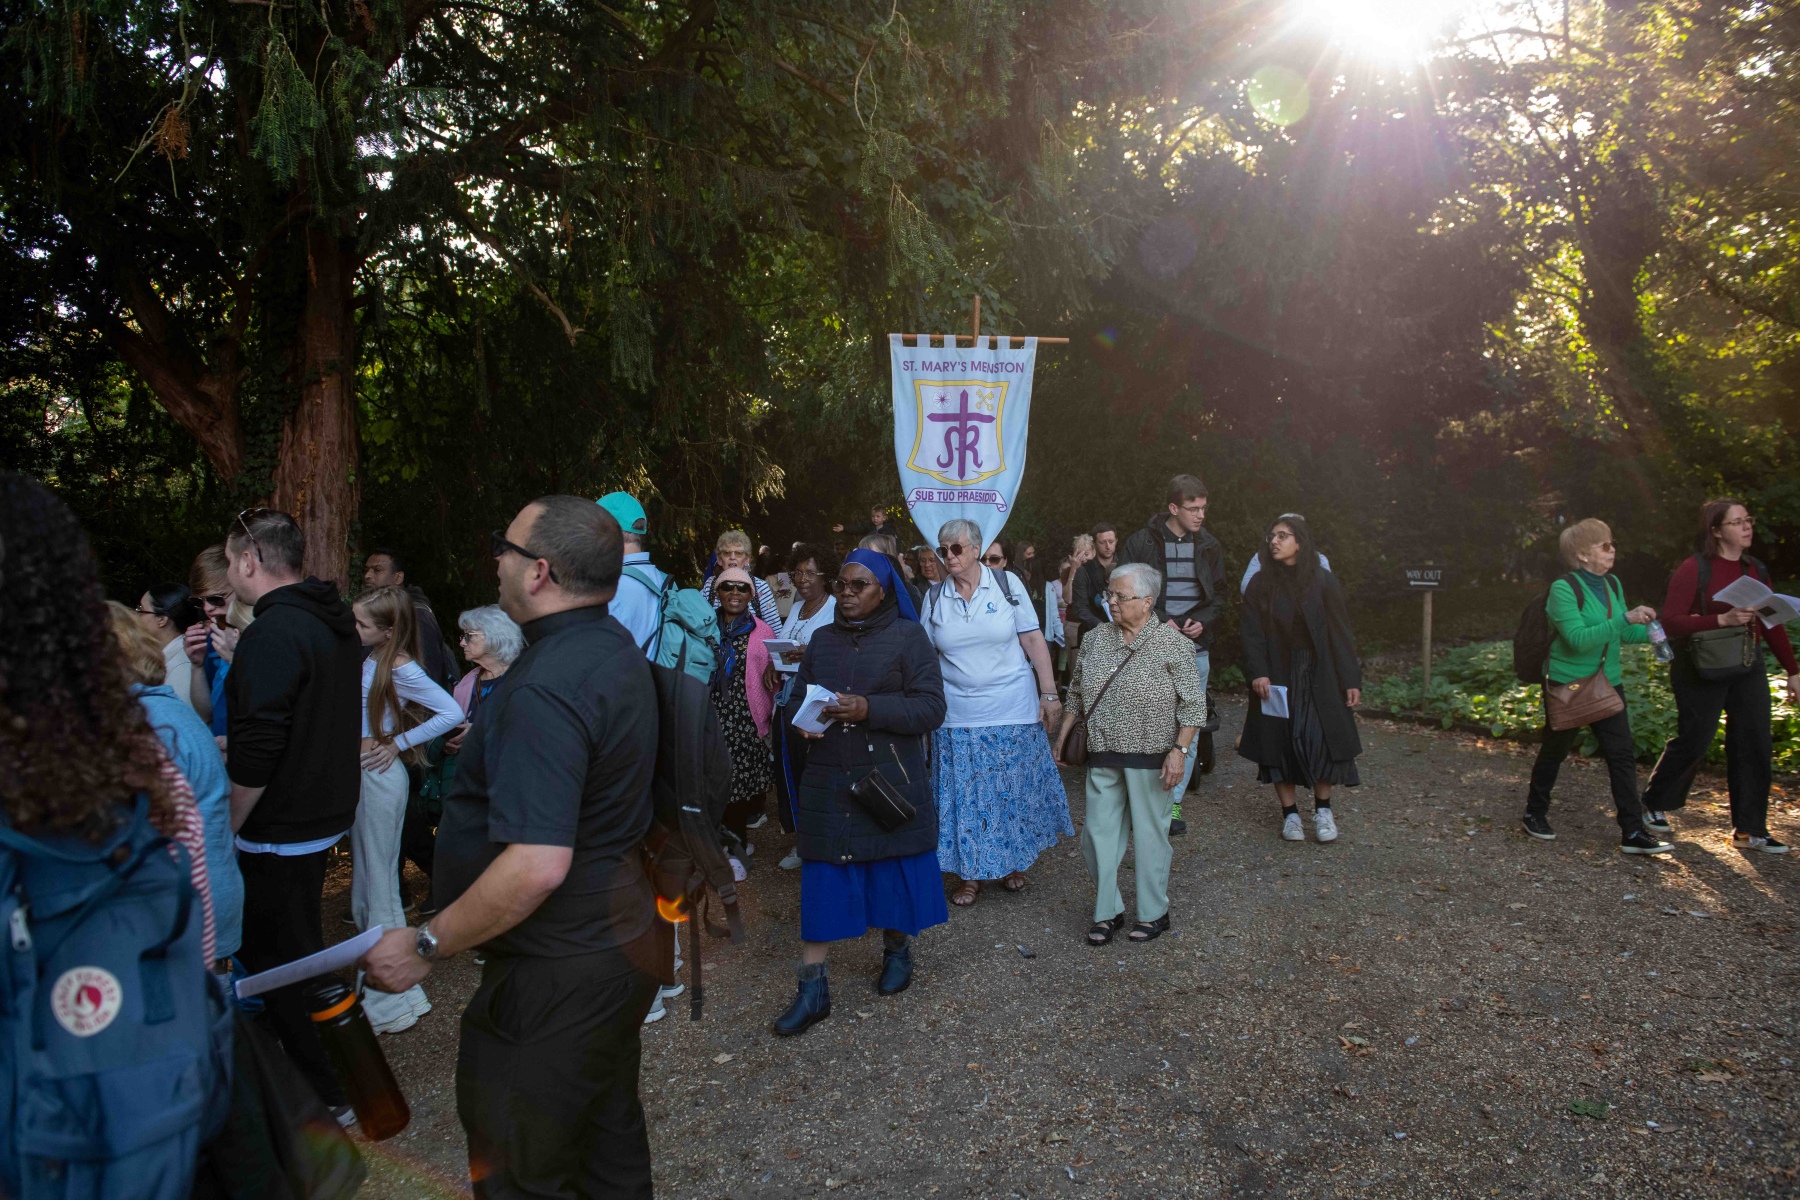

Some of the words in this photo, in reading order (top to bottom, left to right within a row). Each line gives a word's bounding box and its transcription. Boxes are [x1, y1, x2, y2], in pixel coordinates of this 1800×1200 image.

[902, 360, 918, 372] ST.
[921, 360, 967, 373] MARY'S
[970, 360, 1025, 374] MENSTON
[915, 490, 934, 501] SUB
[937, 491, 955, 502] TUO
[957, 491, 997, 503] PRAESIDIO
[1405, 569, 1422, 580] WAY
[1424, 569, 1442, 580] OUT
